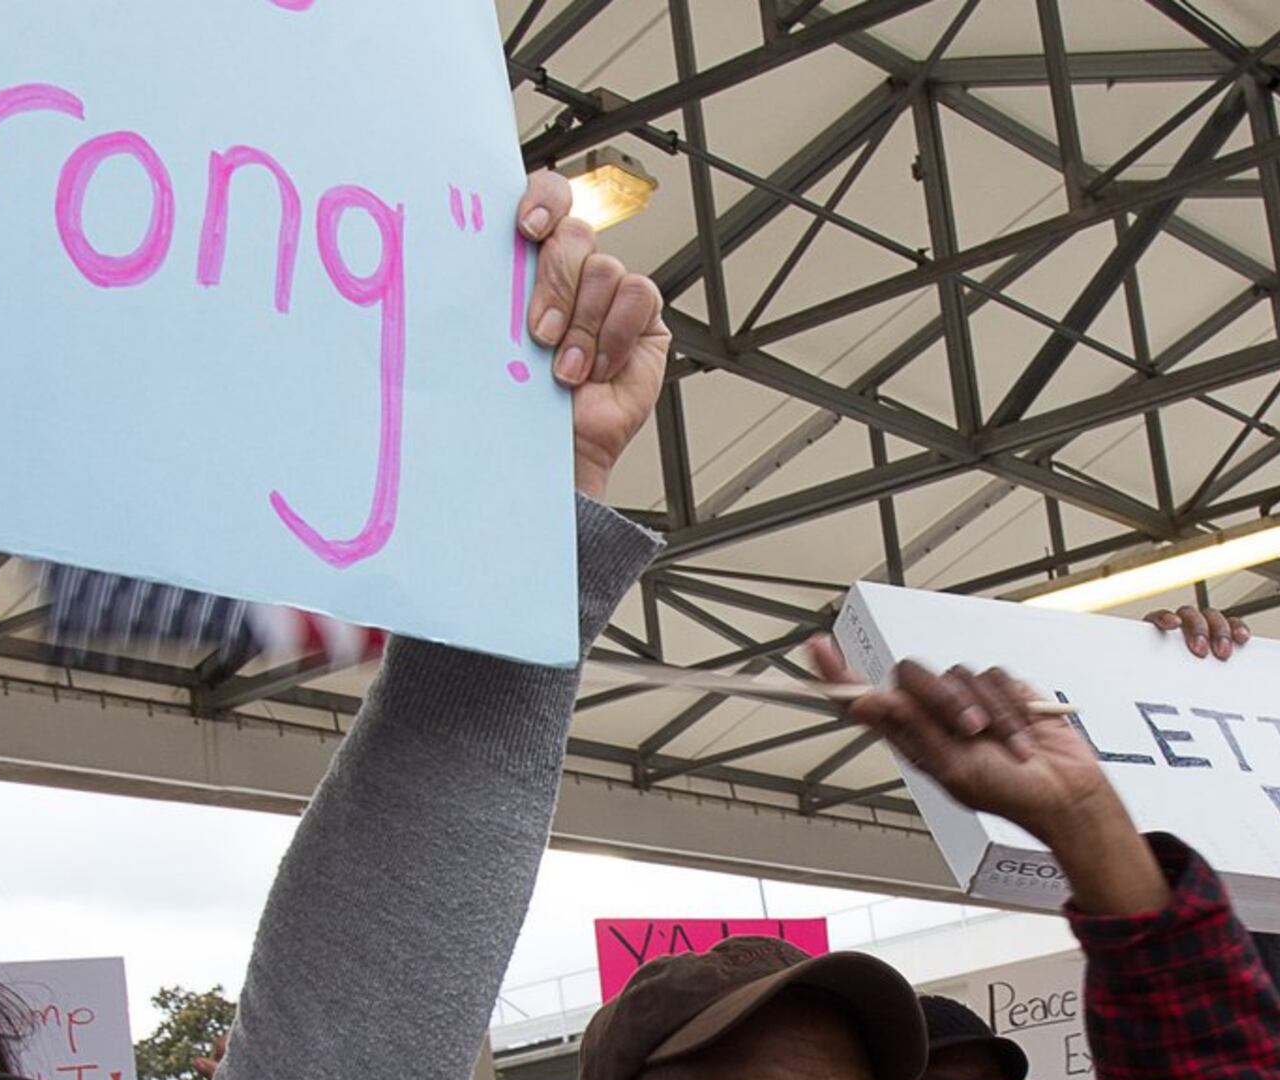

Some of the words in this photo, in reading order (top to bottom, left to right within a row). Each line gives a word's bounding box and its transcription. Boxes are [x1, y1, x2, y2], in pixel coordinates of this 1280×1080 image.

[1054, 691, 1252, 772] LET
[996, 860, 1067, 880] GEO
[988, 981, 1077, 1035] Peace
